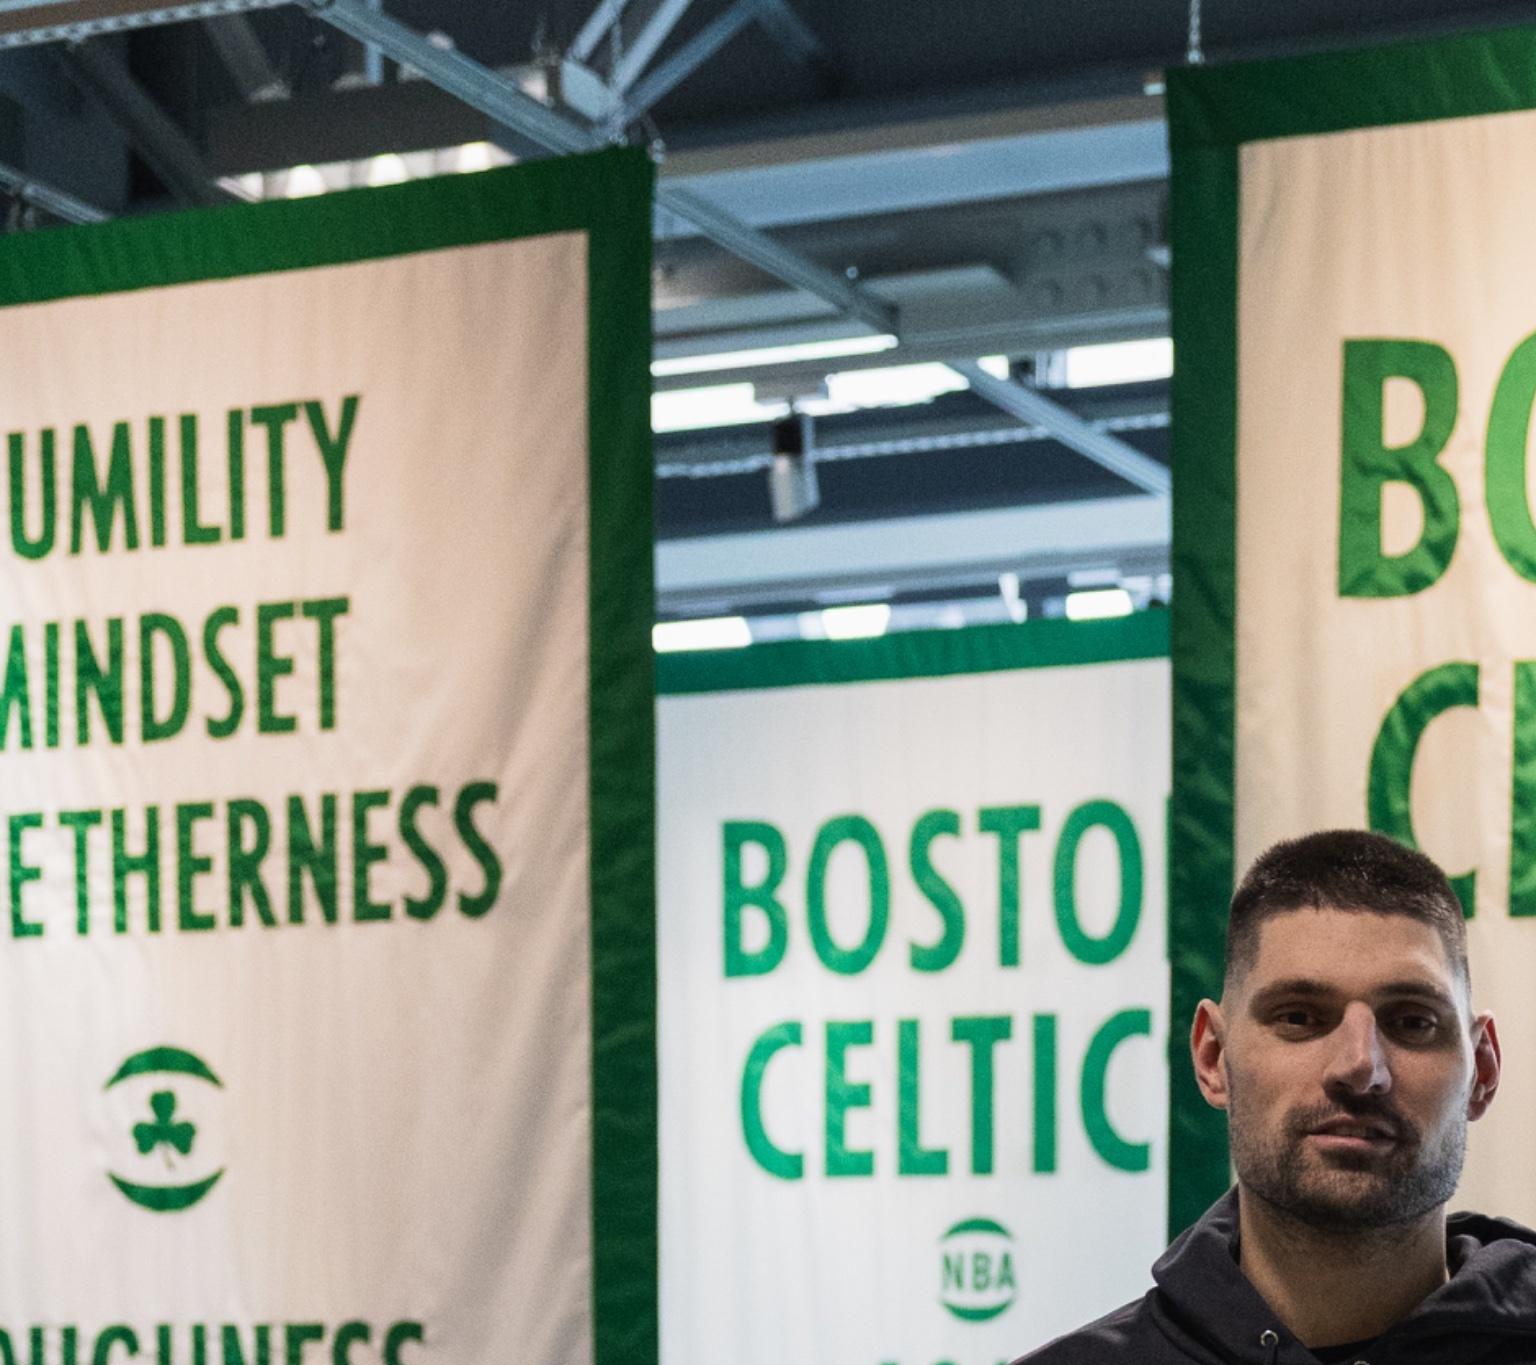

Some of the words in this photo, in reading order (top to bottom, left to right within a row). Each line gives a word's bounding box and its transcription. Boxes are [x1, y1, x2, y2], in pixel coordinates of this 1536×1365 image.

[7, 396, 360, 560] UMILITY
[8, 781, 502, 939] ETHERNESS
[721, 798, 1170, 980] BOSTO
[737, 1006, 1169, 1183] CELTIC
[941, 1250, 1018, 1293] NBA
